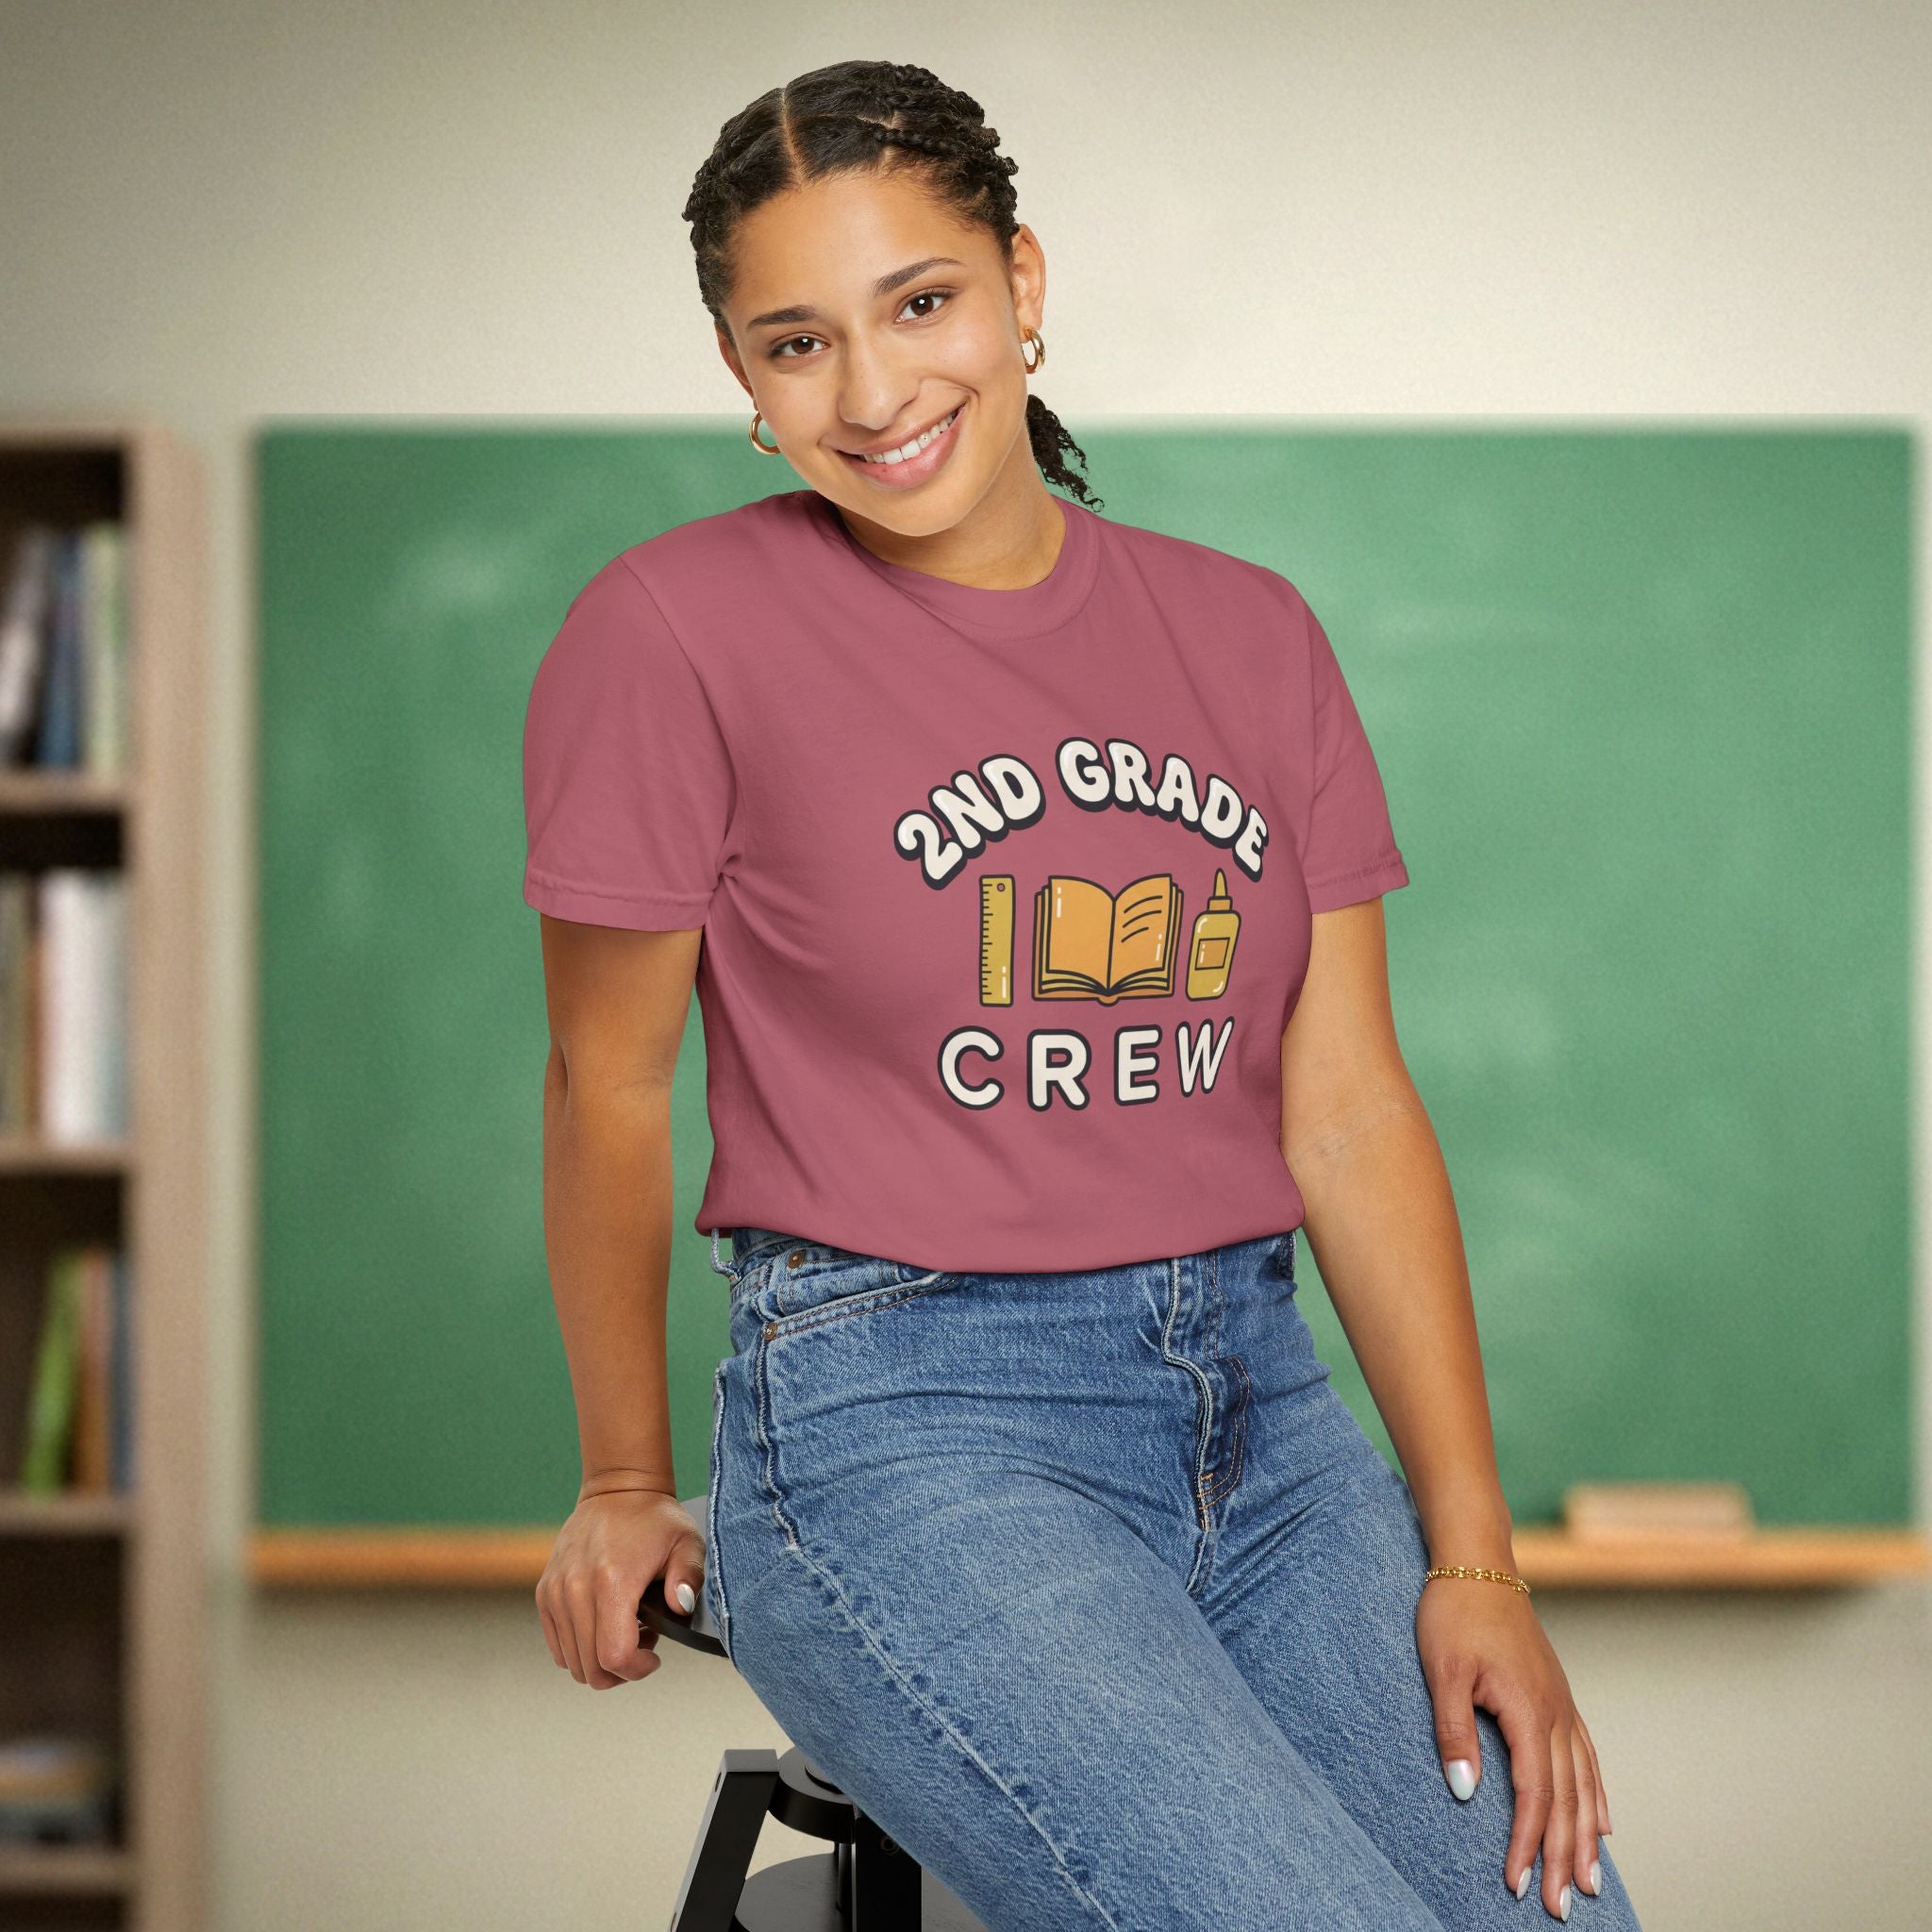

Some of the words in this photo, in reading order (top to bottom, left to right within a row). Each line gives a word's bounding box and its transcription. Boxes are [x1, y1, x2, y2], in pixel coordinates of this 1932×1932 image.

[894, 754, 1046, 890] 2ND
[1056, 737, 1269, 882] GRADE
[938, 1016, 1235, 1111] CREW
